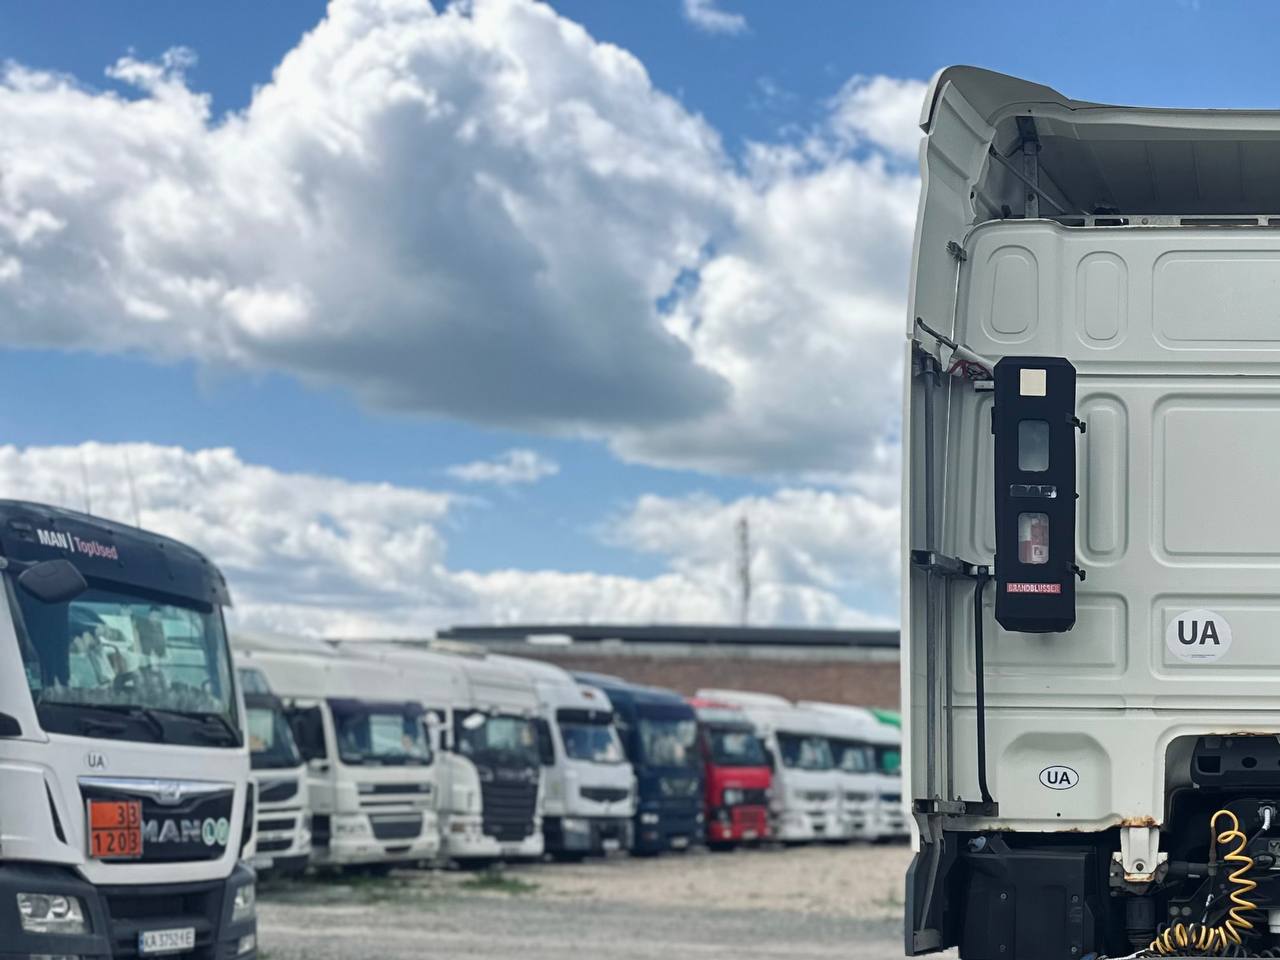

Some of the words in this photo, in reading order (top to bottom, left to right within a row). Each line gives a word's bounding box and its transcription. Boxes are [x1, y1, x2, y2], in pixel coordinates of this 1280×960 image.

[36, 529, 68, 549] MAN
[73, 536, 118, 560] TopUsed
[1178, 620, 1220, 645] UA
[88, 754, 105, 768] UA
[1047, 771, 1071, 785] UA
[94, 831, 138, 852] 1203
